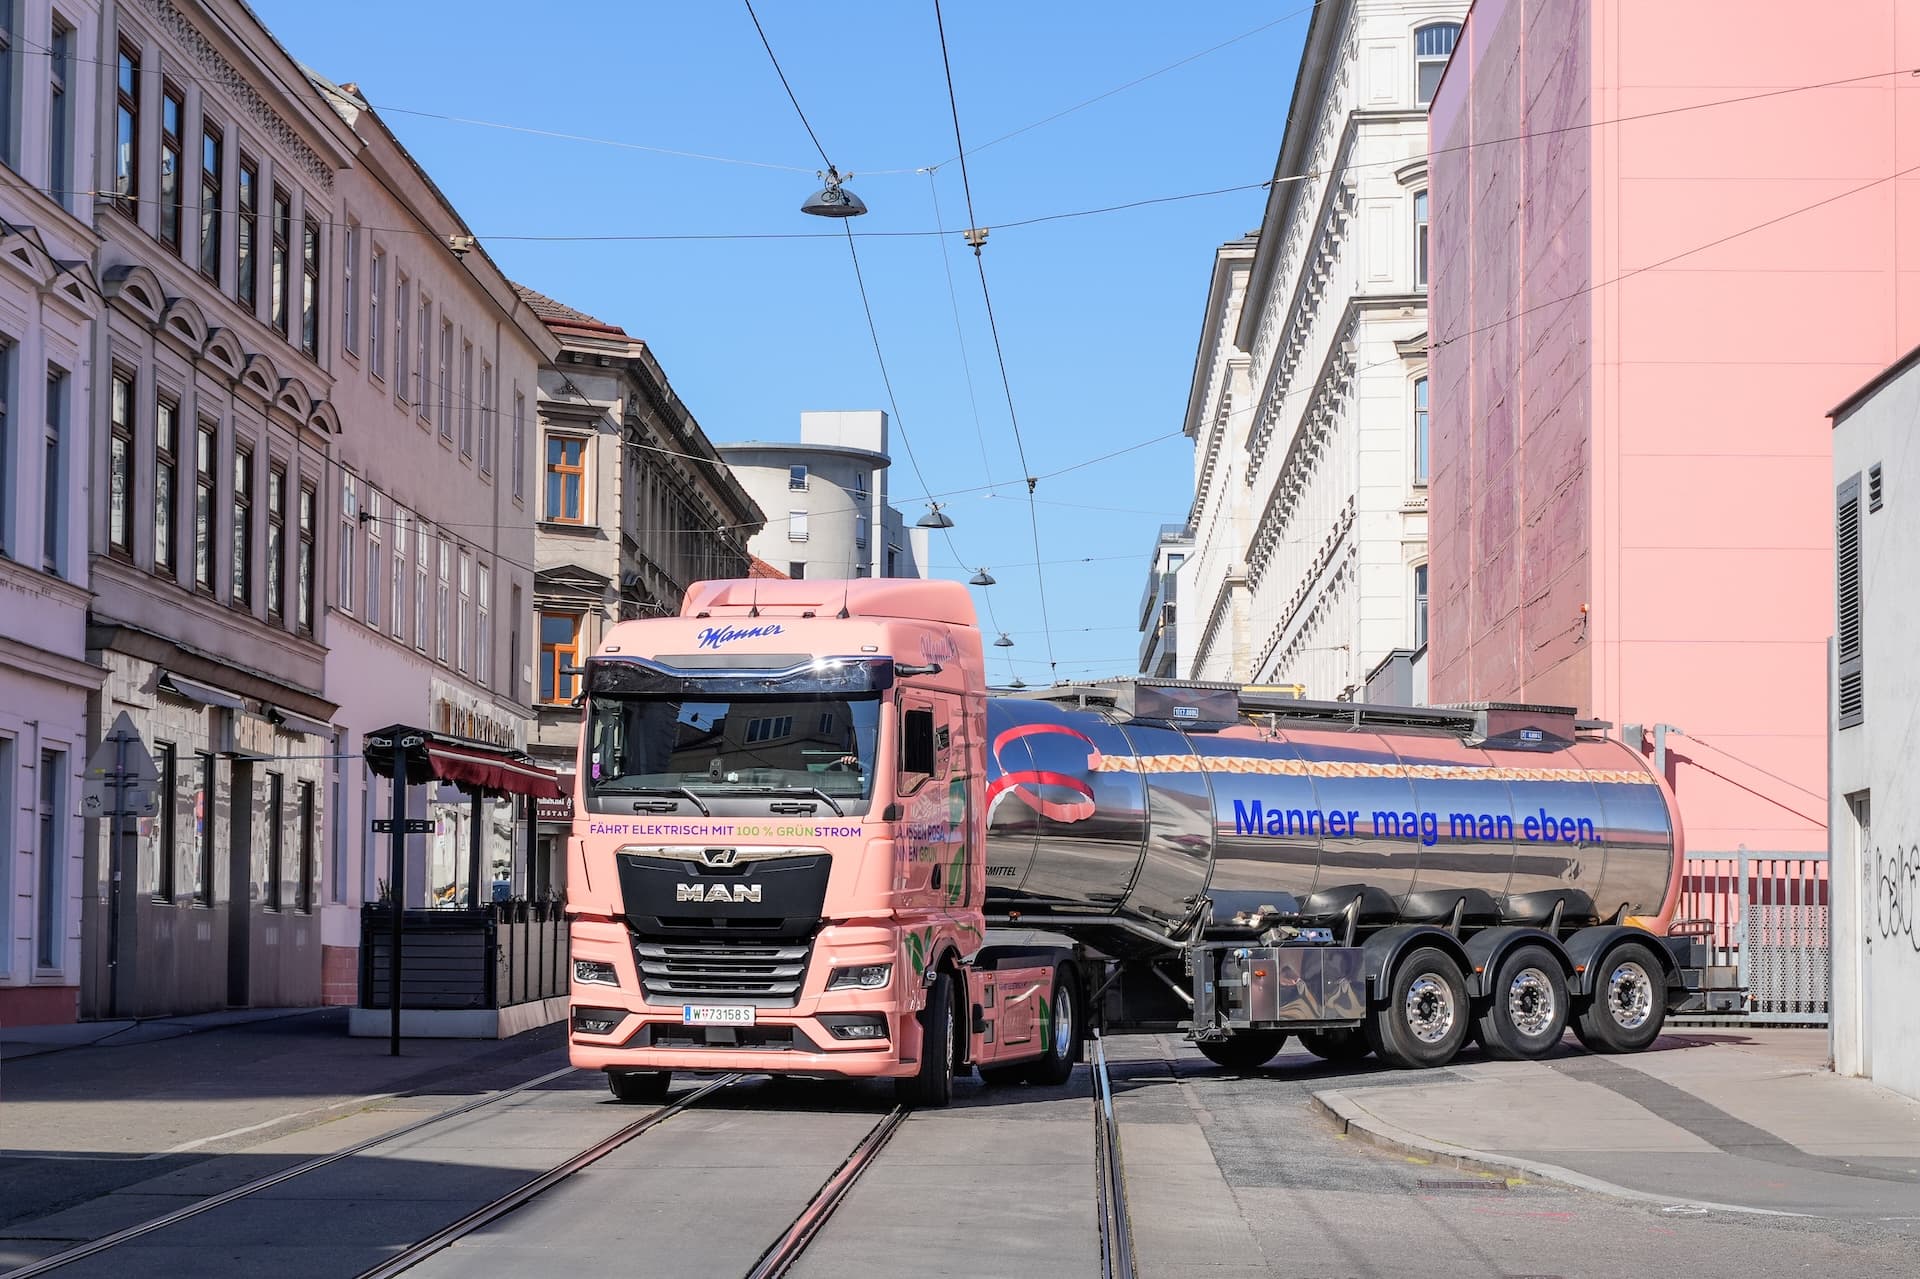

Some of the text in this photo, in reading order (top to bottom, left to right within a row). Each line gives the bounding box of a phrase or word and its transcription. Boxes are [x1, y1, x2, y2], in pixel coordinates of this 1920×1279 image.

[697, 624, 786, 649] Manner
[590, 822, 861, 837] FÄHRT ELEKTRISCH MIT 100 % GRÜNSTROM
[1233, 799, 1602, 847] Manner mag man eben.
[676, 883, 762, 903] MAN
[693, 1008, 701, 1020] W
[709, 1008, 741, 1021] 73158
